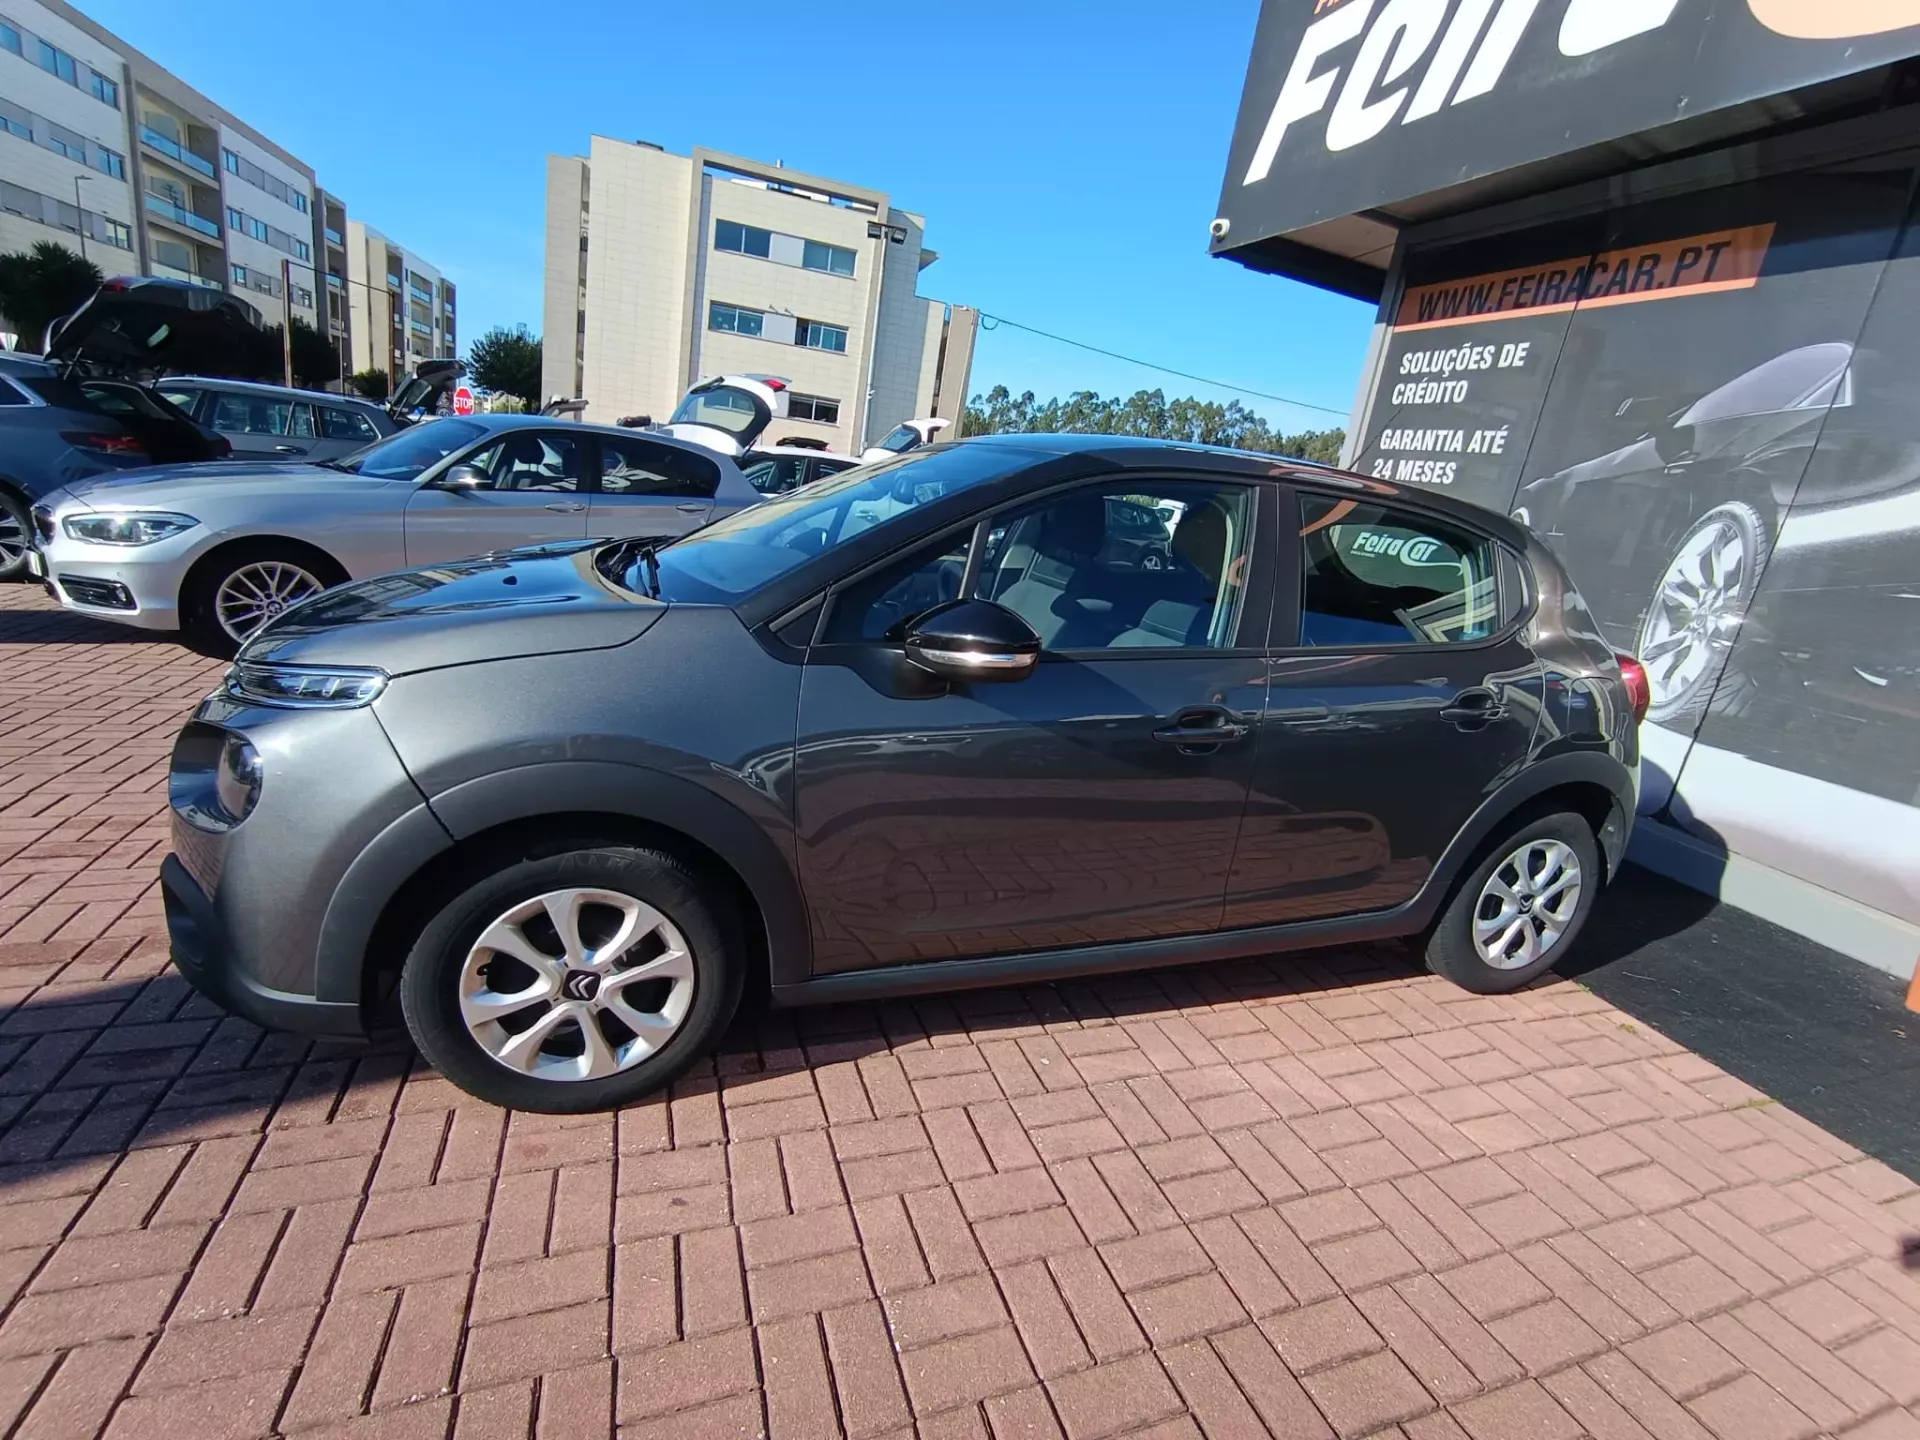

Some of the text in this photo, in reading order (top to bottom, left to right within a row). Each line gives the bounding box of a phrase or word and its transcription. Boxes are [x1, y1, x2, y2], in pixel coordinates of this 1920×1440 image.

[1417, 240, 1732, 323] WWW.FEIRACAR.PT
[1399, 341, 1531, 378] SOLUÇÕES DE
[455, 397, 473, 410] STOP
[1391, 376, 1469, 405] CRÉDITO
[1379, 424, 1509, 454] GARANTIA ATÉ
[1372, 458, 1457, 485] 24 MESES
